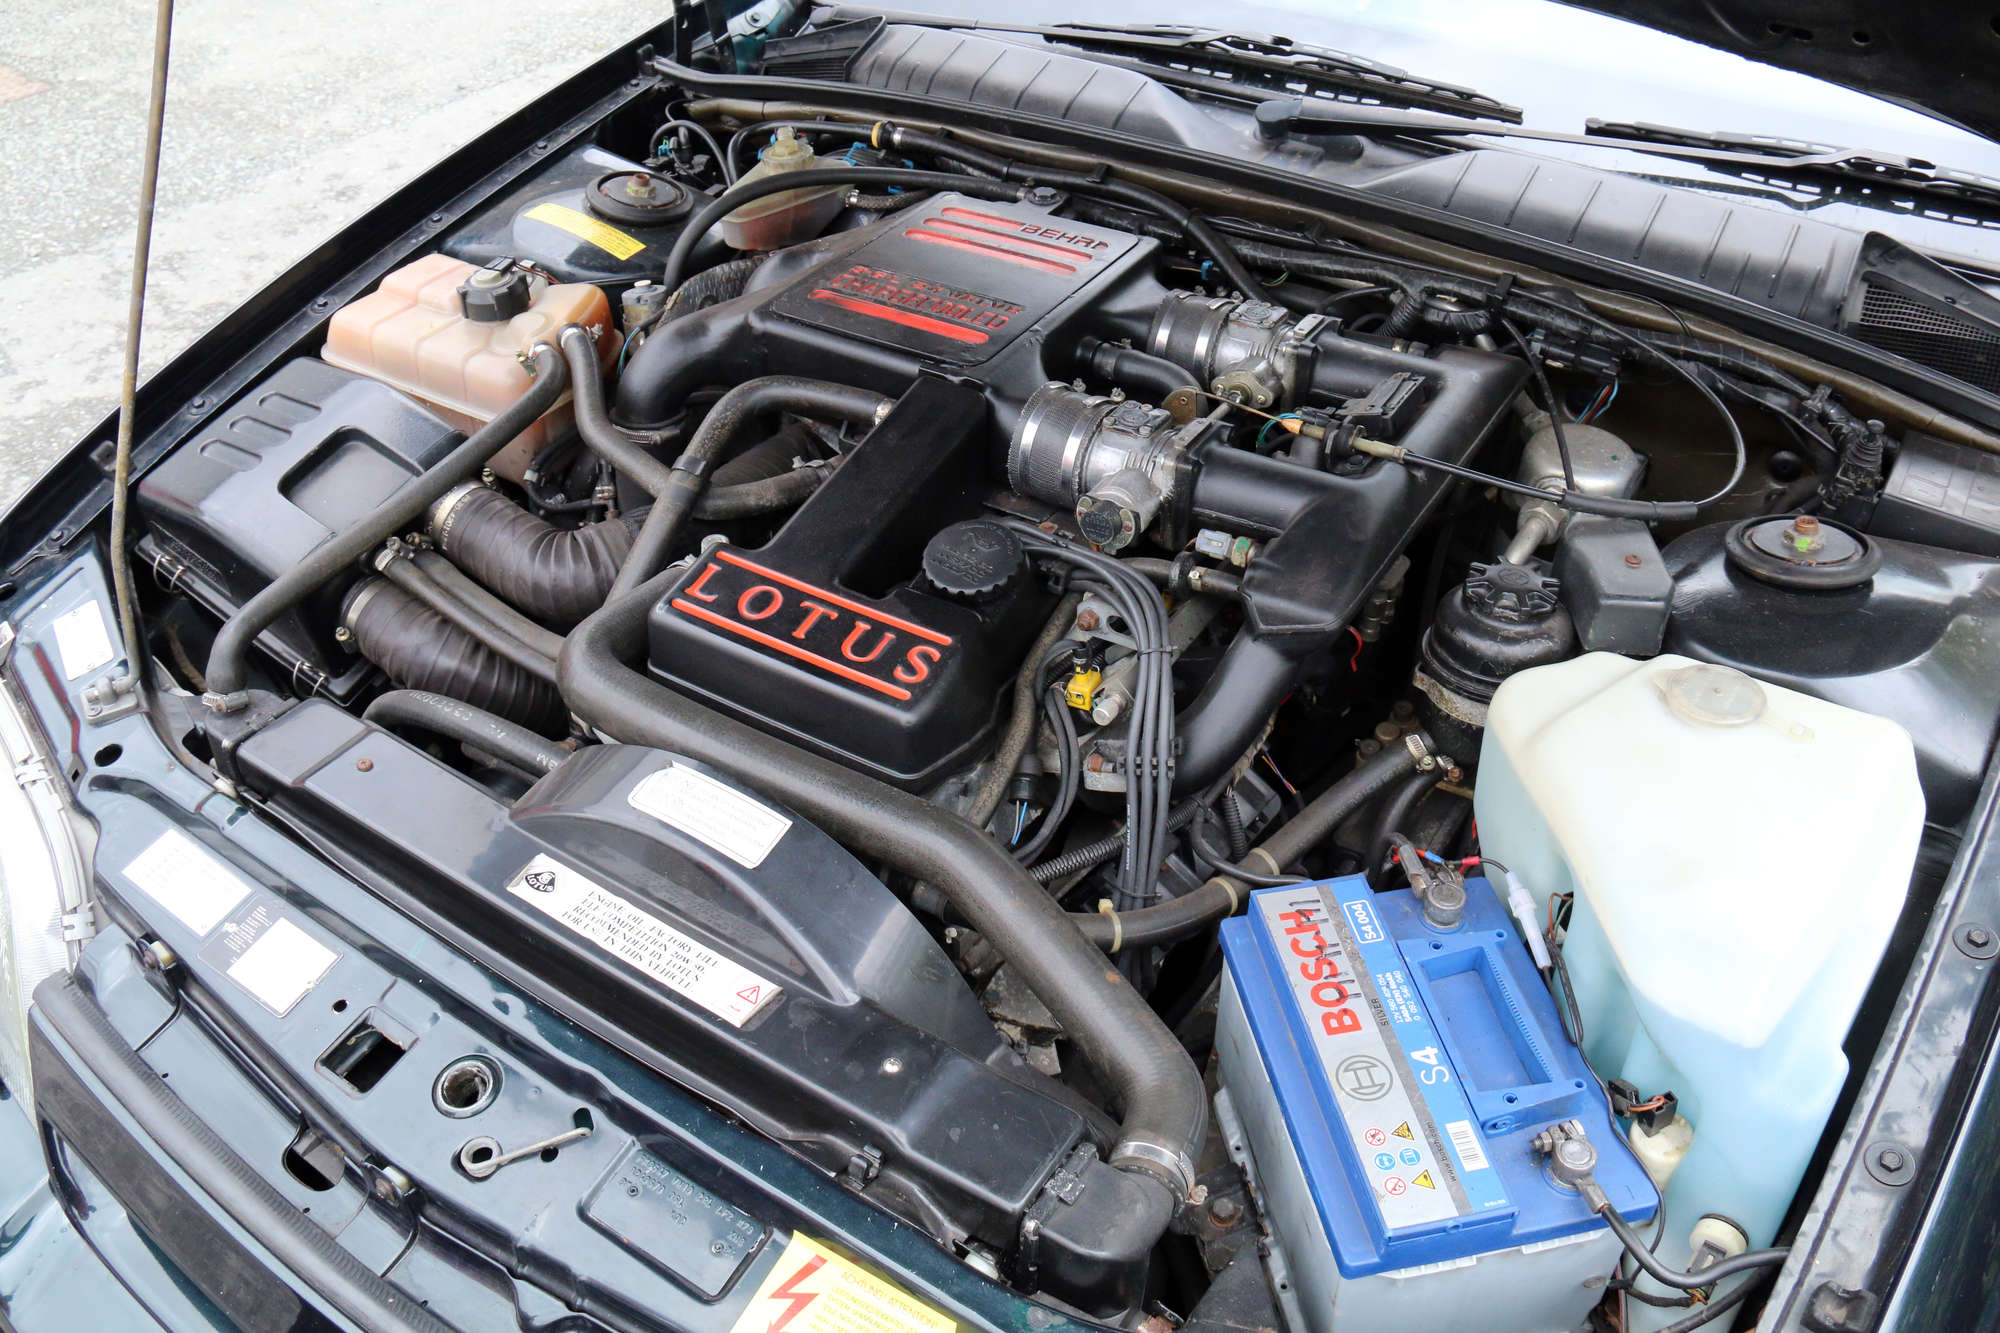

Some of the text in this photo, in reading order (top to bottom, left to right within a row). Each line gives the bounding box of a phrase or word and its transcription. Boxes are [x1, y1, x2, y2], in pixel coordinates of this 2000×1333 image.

[1019, 224, 1097, 250] BEHR
[830, 273, 1012, 330] CHARGECOOLED
[684, 562, 943, 684] LOTUS
[526, 873, 554, 893] LOTUS
[562, 910, 582, 925] FOR
[603, 934, 615, 946] IN
[620, 944, 644, 962] THIS
[572, 904, 649, 953] RECOMMENDED
[649, 949, 663, 960] BY
[588, 889, 625, 914] ENGINE
[649, 924, 693, 952] FACTORY
[602, 909, 669, 952] COMPETITION
[1350, 903, 1377, 940] S4 004
[1279, 909, 1362, 1037] BOSCH
[1371, 998, 1389, 1026] SILVER
[1410, 1046, 1450, 1085] S4
